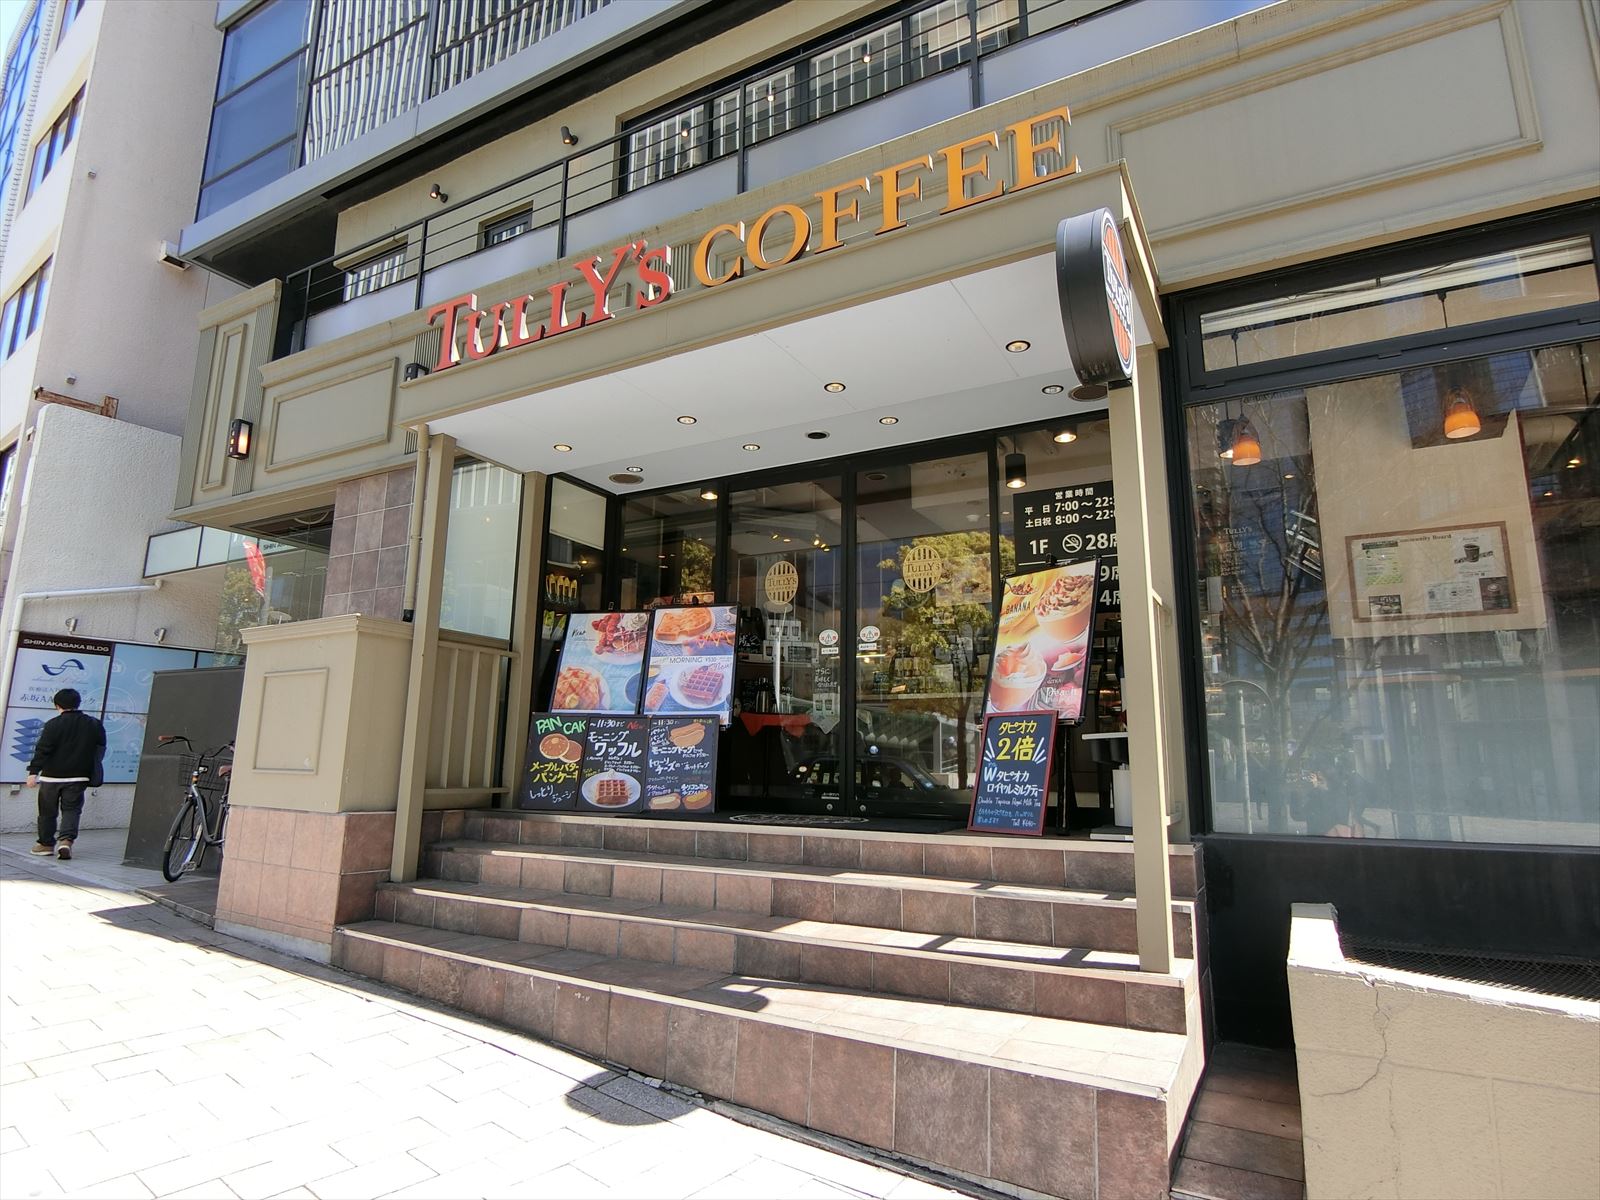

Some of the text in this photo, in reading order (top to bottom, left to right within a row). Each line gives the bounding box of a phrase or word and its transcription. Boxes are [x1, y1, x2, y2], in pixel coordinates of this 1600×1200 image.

[693, 105, 1081, 287] COFFEE
[1055, 487, 1094, 500] 営業時間
[1025, 517, 1051, 528] 土日祝
[1029, 539, 1048, 554] 1F
[1006, 600, 1031, 614] BANANA
[23, 638, 45, 646] SHIN
[46, 641, 85, 650] AKASAKA
[669, 656, 703, 664] MORNING
[536, 716, 563, 735] PAN
[999, 720, 1037, 735] タピオカ
[588, 731, 630, 742] モーニング
[594, 742, 642, 757] ワッフル
[996, 735, 1035, 761] 2倍
